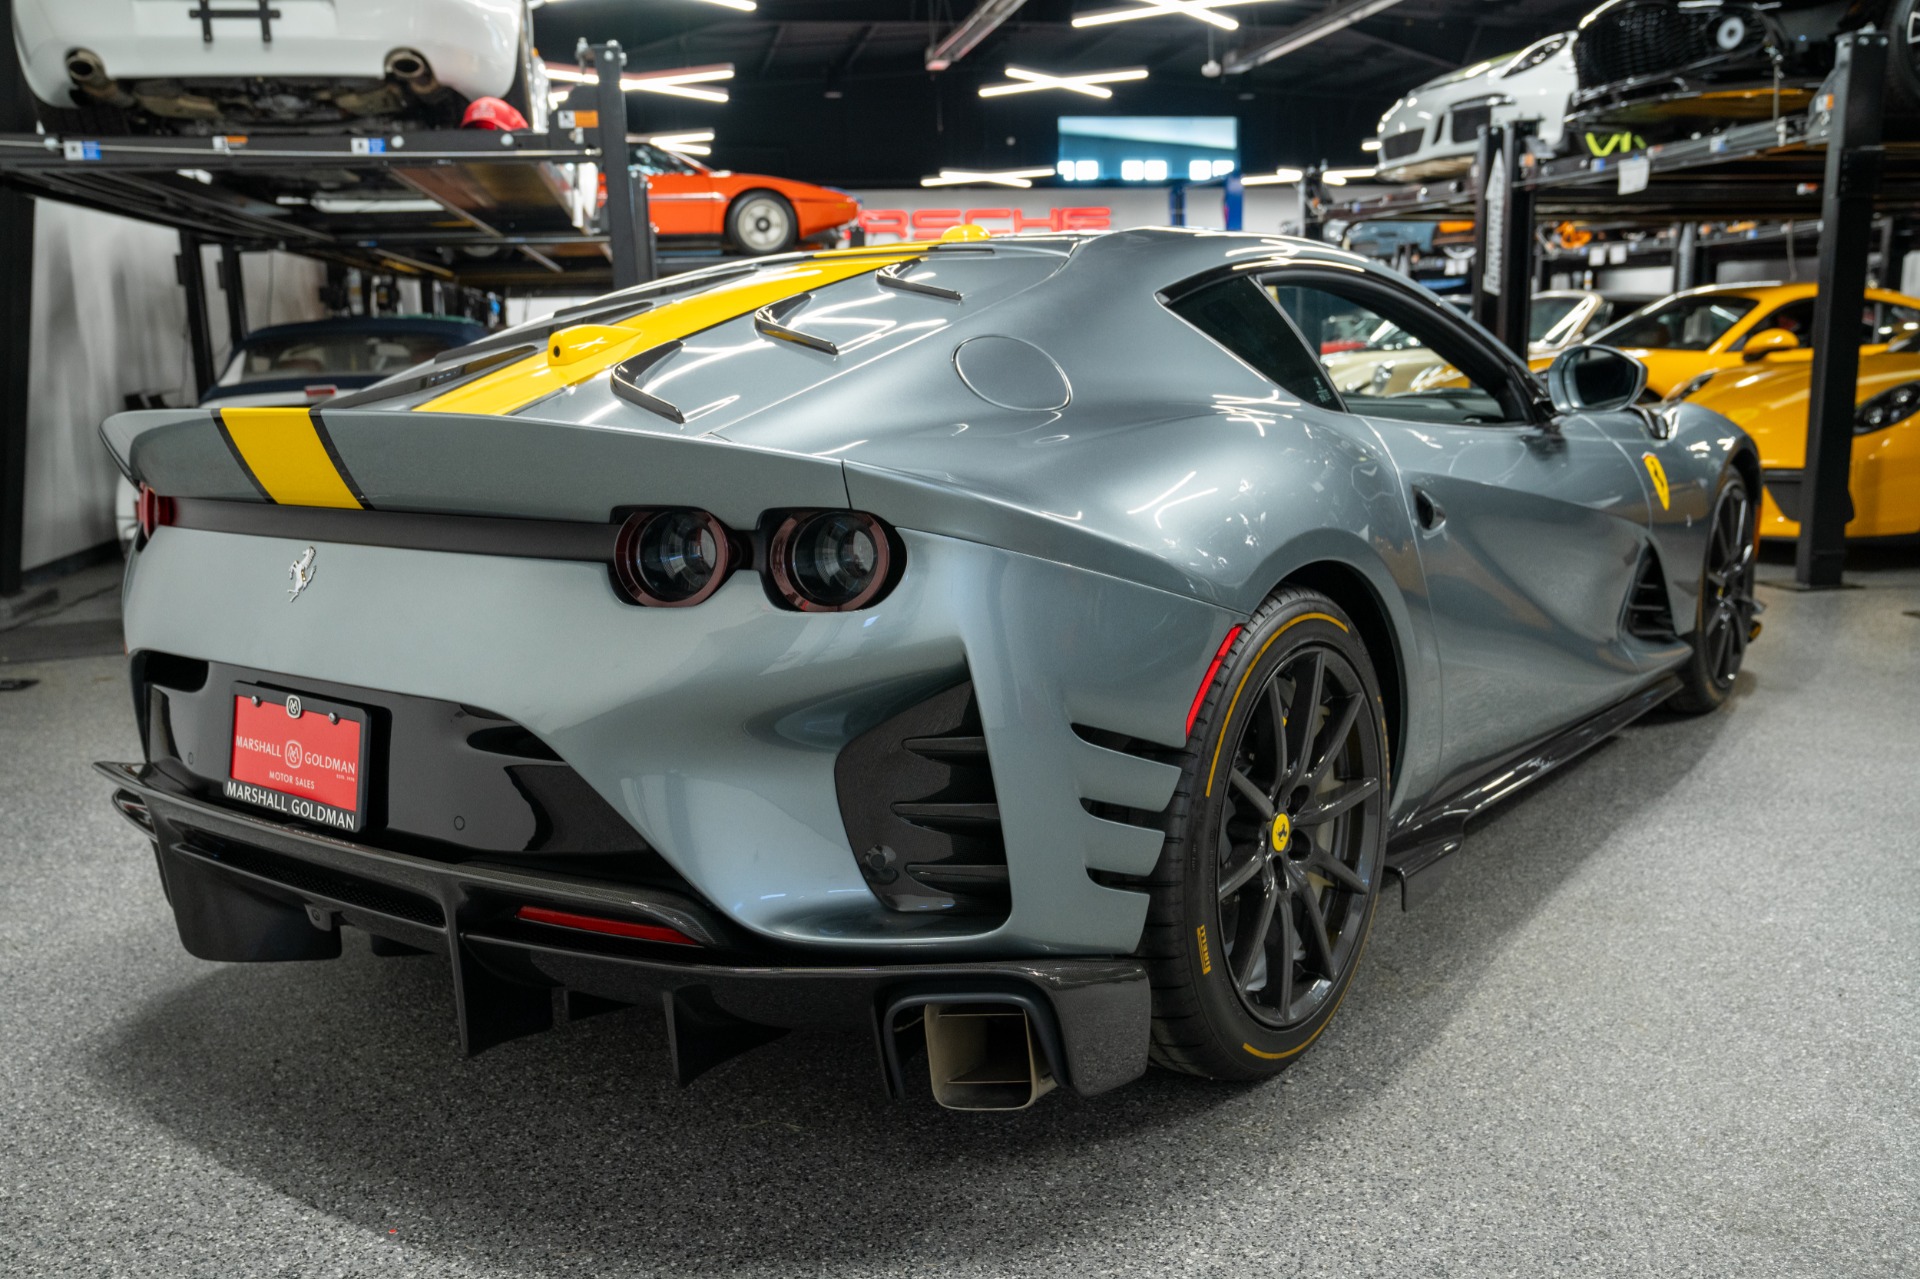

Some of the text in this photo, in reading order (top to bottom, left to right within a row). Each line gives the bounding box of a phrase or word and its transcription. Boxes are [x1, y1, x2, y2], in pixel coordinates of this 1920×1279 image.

[857, 207, 1111, 239] RSCHE
[236, 735, 282, 758] MARSHALL
[304, 751, 356, 775] GOLDMAN
[269, 770, 315, 790] MOTOR SALES
[227, 781, 355, 830] MARSHALL GOLDMAN
